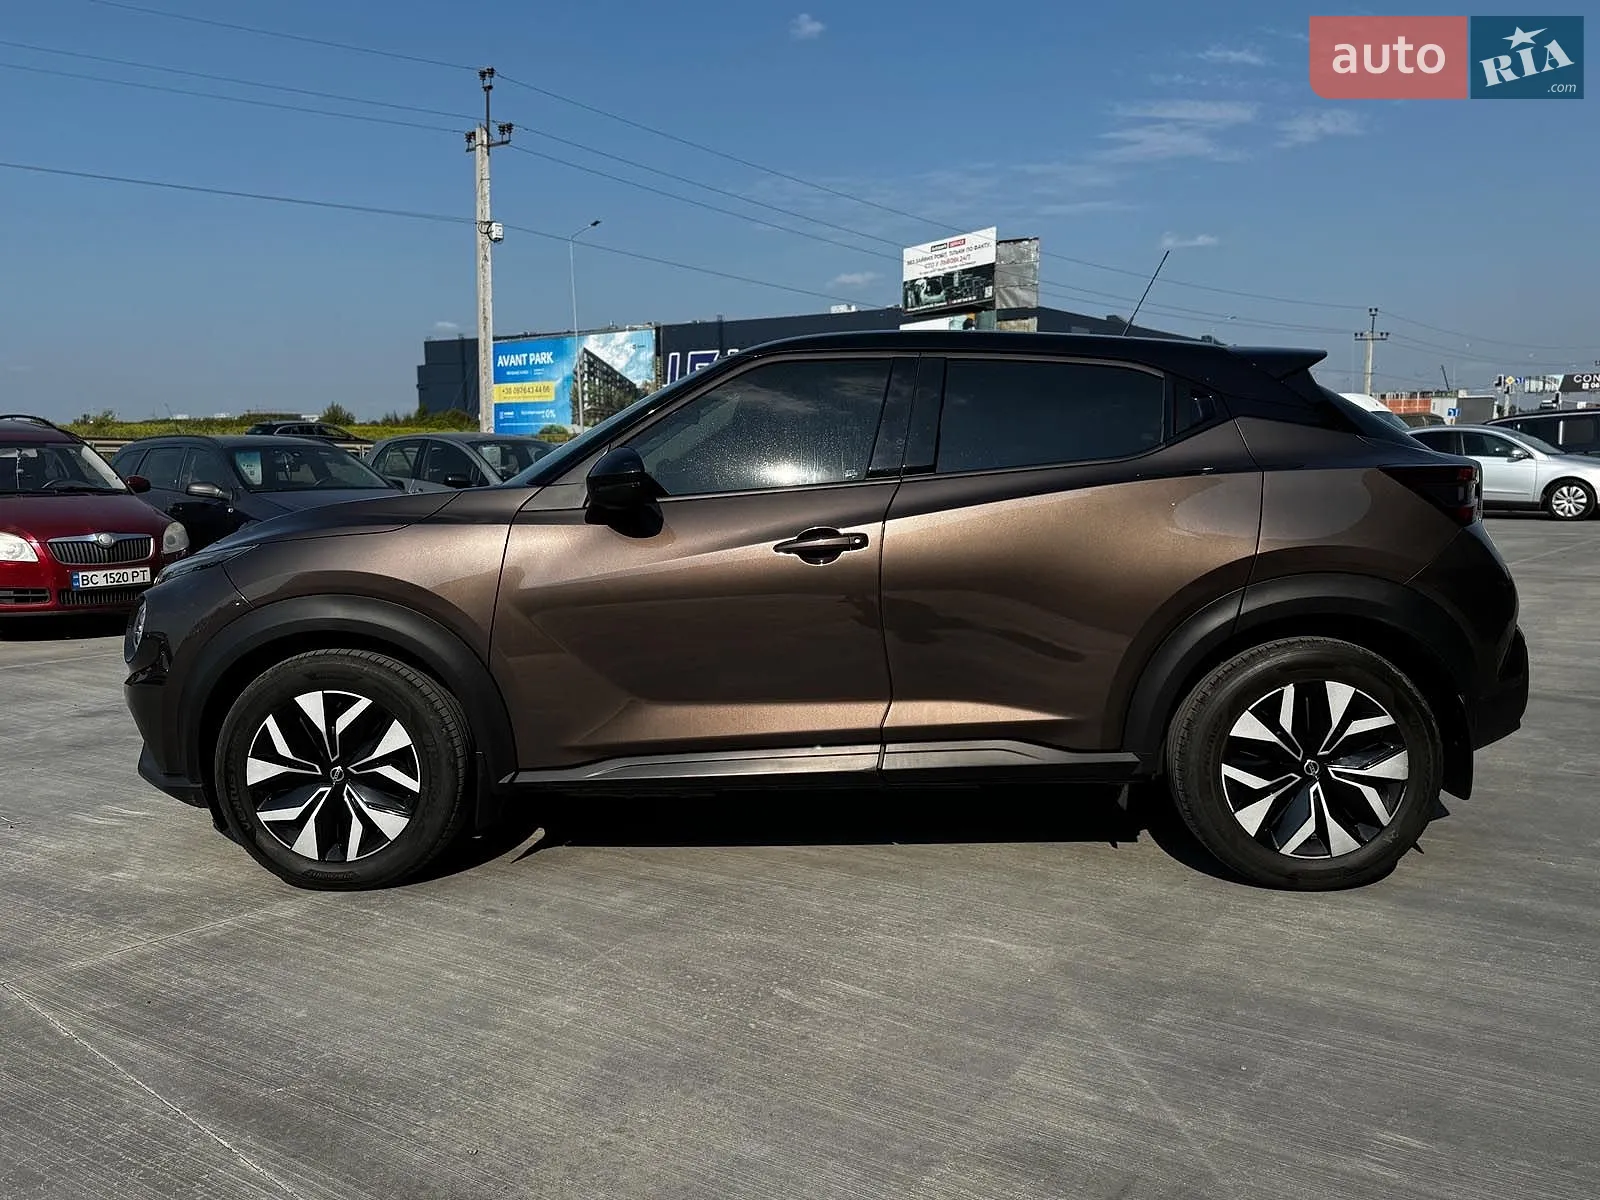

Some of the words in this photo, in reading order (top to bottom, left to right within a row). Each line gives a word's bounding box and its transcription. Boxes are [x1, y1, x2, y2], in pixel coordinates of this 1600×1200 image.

[497, 353, 528, 367] AVANT
[529, 351, 554, 366] PARK
[81, 574, 99, 586] BC
[102, 571, 129, 585] 1520
[131, 570, 148, 582] PT
